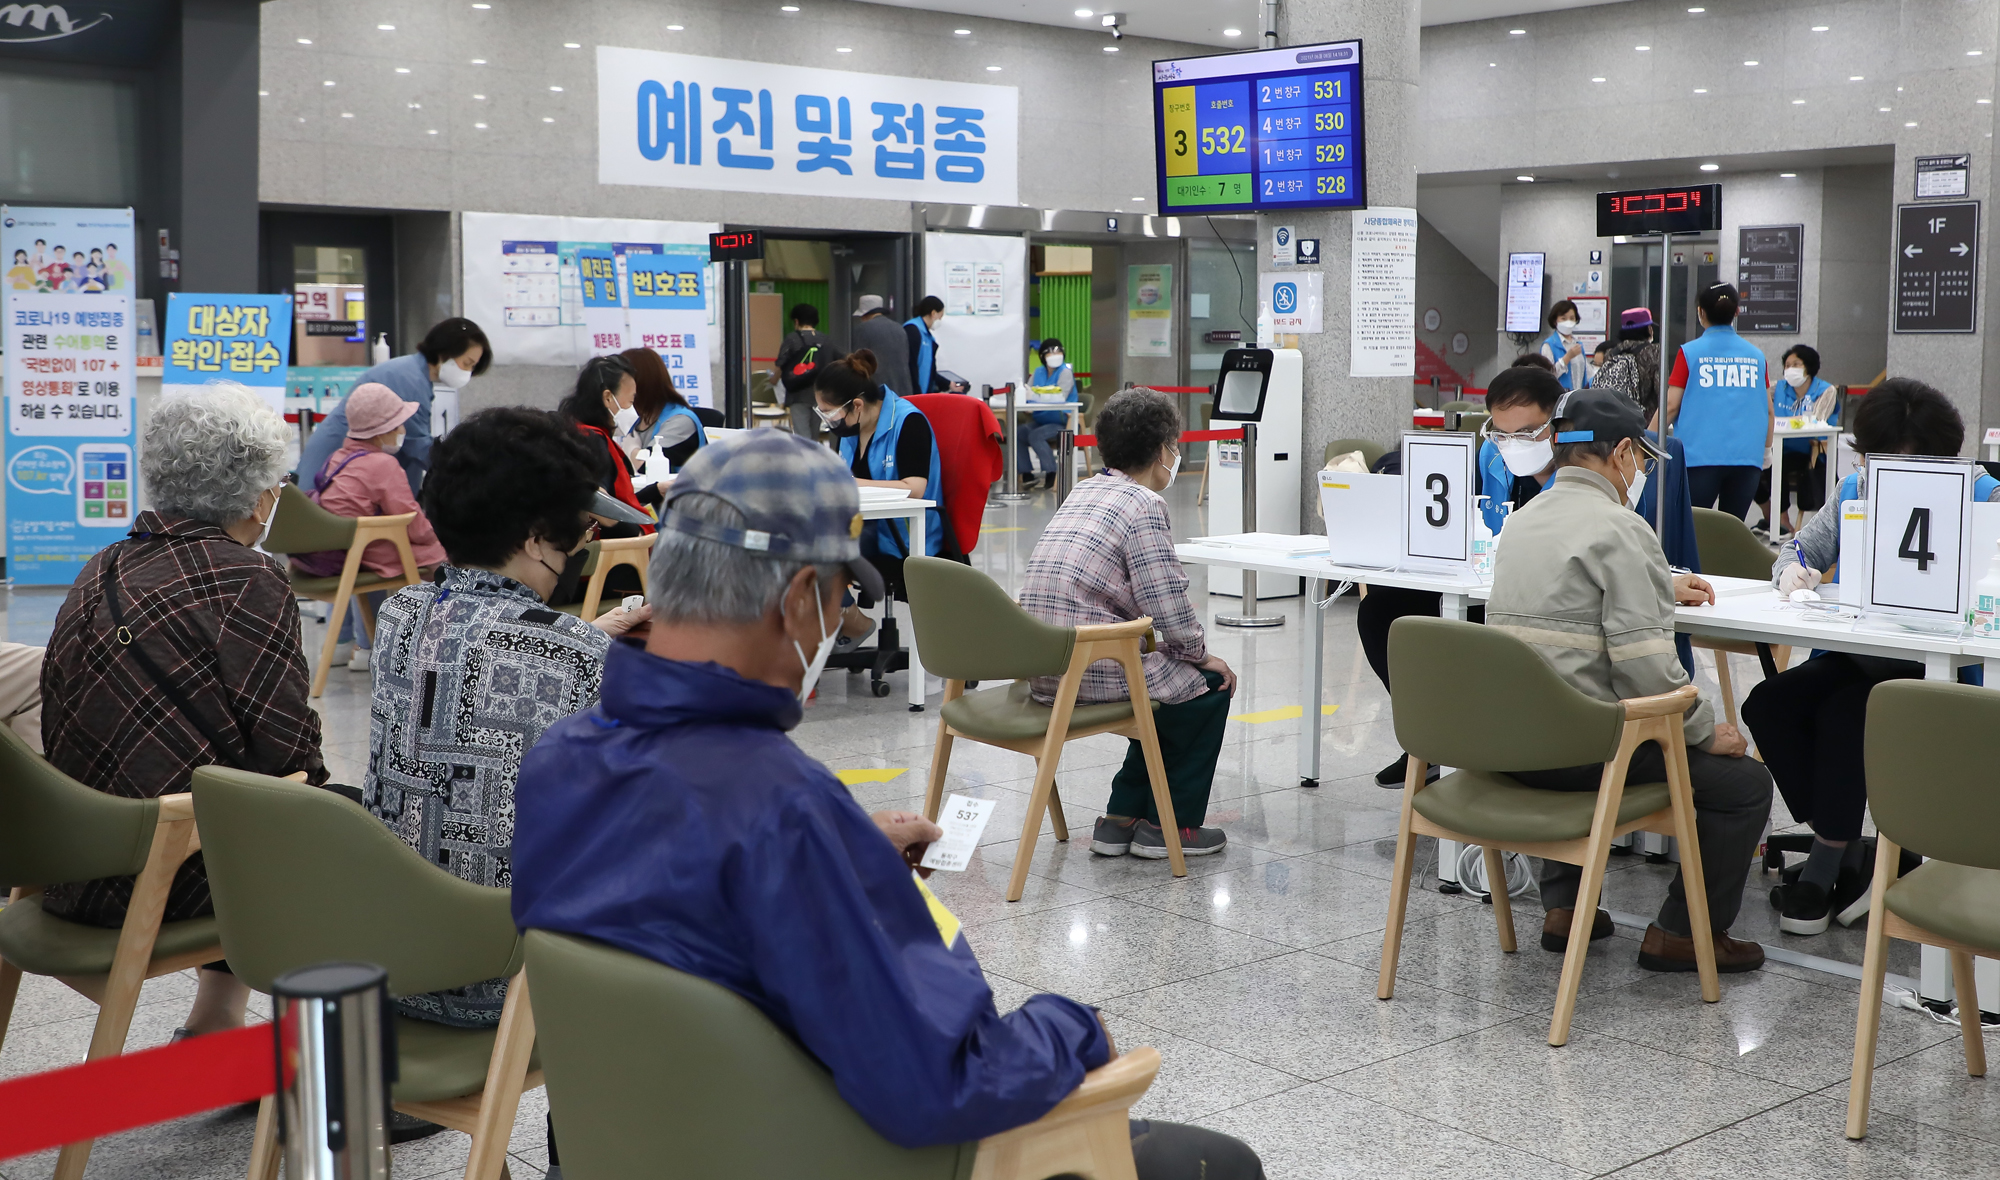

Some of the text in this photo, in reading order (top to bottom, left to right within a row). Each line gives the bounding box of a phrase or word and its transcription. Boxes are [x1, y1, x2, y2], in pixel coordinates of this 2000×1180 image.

[1261, 80, 1341, 103] 2 번 창구 531
[1168, 103, 1191, 114] 창구번호
[1210, 99, 1234, 109] 호출번호
[637, 80, 987, 184] 예진 및 접종
[1262, 112, 1344, 133] 4 번 창구 530
[1174, 129, 1188, 157] 3
[1201, 125, 1246, 155] 532
[1264, 143, 1345, 165] 1 번 창구 529
[1177, 185, 1207, 197] 대기인수
[1218, 182, 1226, 196] 7
[1233, 183, 1242, 195] 명
[1264, 175, 1346, 195] 2 번 창구 528
[1928, 217, 1947, 234] 1F
[581, 256, 614, 279] 예진표
[584, 279, 617, 301] 확 인
[632, 270, 700, 298] 번호표
[15, 310, 124, 328] 코로나19 예방접종
[188, 305, 271, 338] 대상자
[22, 334, 118, 351] 관련 수어통역은
[593, 333, 621, 348] 체온측정
[642, 333, 696, 349] 번호표를
[82, 359, 106, 372] 107
[171, 338, 281, 374] 확인·접수
[1699, 363, 1759, 389] STAFF
[94, 381, 120, 397] 이용
[21, 403, 123, 419] 하실 수 있습니다.
[1425, 473, 1451, 528] 3
[1898, 507, 1936, 572] 4
[1983, 598, 1993, 609] H
[956, 809, 979, 821] 537
